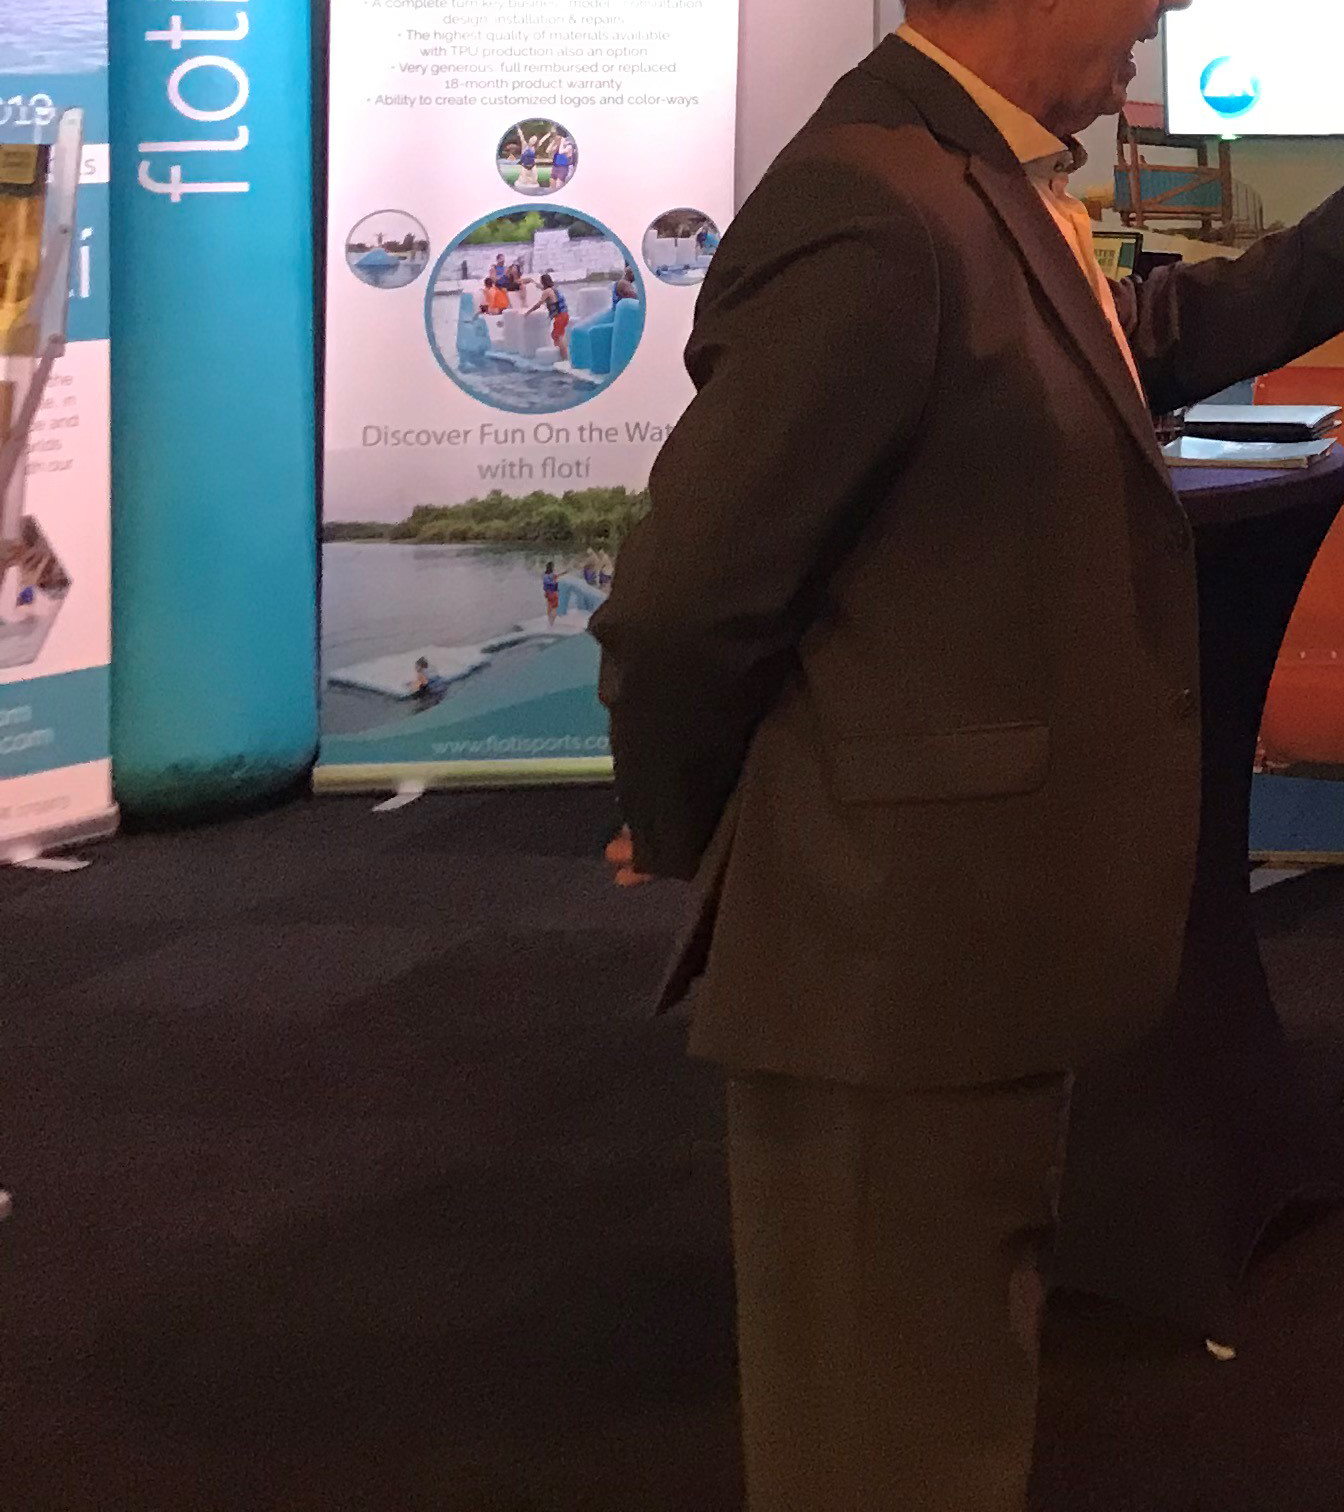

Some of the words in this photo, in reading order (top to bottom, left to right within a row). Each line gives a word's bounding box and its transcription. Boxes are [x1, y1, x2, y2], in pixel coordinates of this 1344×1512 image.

[568, 14, 577, 25] &
[406, 29, 431, 40] The
[433, 29, 482, 43] highest
[486, 29, 529, 42] quality
[533, 29, 546, 40] of
[549, 29, 609, 41] materials
[611, 29, 671, 41] available
[419, 45, 447, 57] with
[449, 45, 479, 57] TPU
[482, 45, 554, 59] production
[557, 46, 584, 57] also
[586, 47, 603, 57] an
[606, 46, 648, 59] option
[399, 62, 428, 75] Very
[499, 61, 521, 73] full
[523, 61, 599, 73] reimbursed
[601, 63, 615, 73] or
[618, 61, 677, 75] replaced
[444, 77, 509, 89] 18-month
[511, 78, 563, 91] product
[567, 78, 623, 92] warranty
[374, 94, 416, 108] Ability
[419, 95, 433, 106] to
[434, 94, 477, 106] create
[480, 94, 557, 106] customized
[559, 94, 596, 108] logos
[599, 94, 624, 105] and
[627, 93, 700, 108] color-ways
[361, 424, 473, 447] Discover
[479, 422, 526, 445] Fun
[532, 421, 571, 445] On
[577, 421, 619, 444] the
[624, 420, 676, 444] Wat
[477, 457, 534, 480] with
